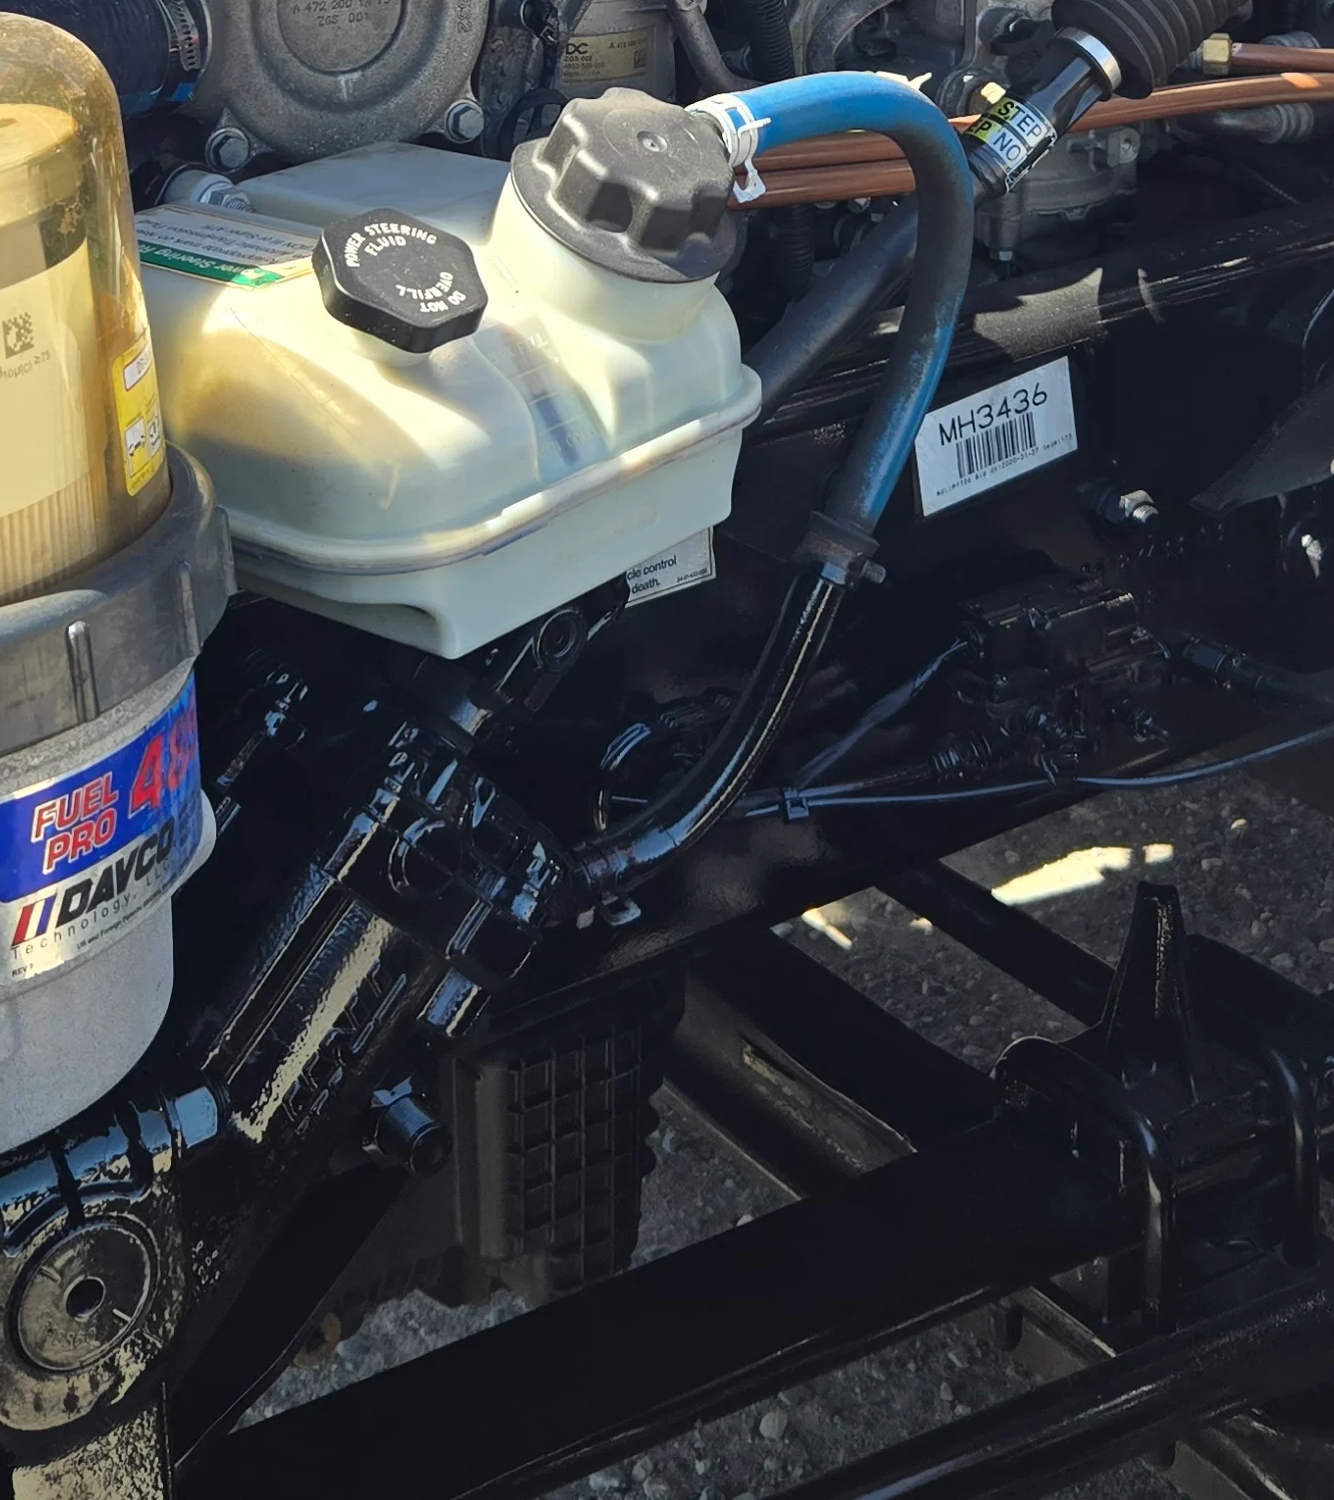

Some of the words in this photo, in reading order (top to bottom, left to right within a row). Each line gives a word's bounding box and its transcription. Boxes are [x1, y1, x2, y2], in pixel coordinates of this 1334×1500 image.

[302, 1, 327, 13] 472
[997, 101, 1042, 137] STEP
[993, 131, 1022, 162] NO
[156, 248, 216, 270] Steering
[344, 232, 366, 267] POWER
[364, 222, 437, 245] STEERING
[364, 235, 407, 256] FLUID
[395, 271, 454, 300] OVERFILL
[447, 290, 467, 306] DO
[420, 300, 449, 313] NOT
[938, 382, 1048, 446] MH3436
[643, 554, 677, 576] control
[631, 576, 661, 594] death.
[30, 771, 119, 844] FUEL
[42, 809, 117, 875] PRO
[55, 817, 176, 929] DAVCO
[145, 858, 171, 888] LLC
